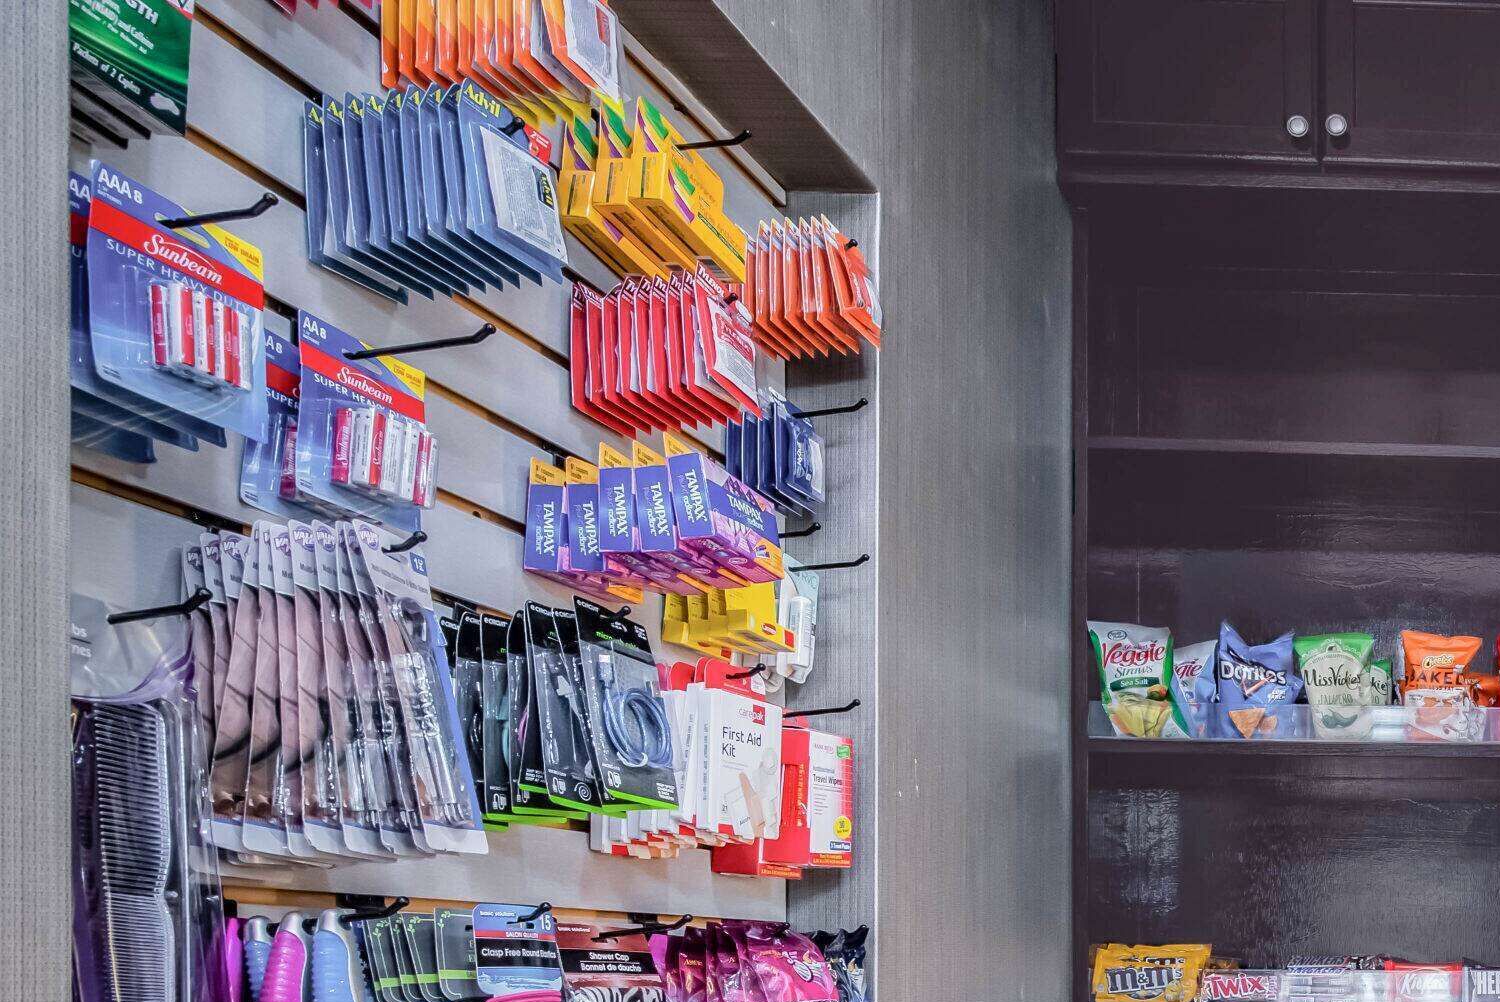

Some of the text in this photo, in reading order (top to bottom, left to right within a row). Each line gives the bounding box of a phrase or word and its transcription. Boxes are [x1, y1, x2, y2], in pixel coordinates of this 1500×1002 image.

[463, 83, 501, 118] Advil
[98, 168, 132, 199] AAA
[143, 233, 224, 286] Sunbeam
[106, 238, 251, 313] SUPER HEAVY DUTY
[303, 316, 319, 336] AA
[314, 372, 349, 397] SUPER
[336, 366, 393, 405] Sunbeam
[684, 468, 708, 522] TAMPAX
[726, 493, 764, 523] TAMPAX
[613, 483, 630, 537] TAMPAX
[650, 481, 671, 536] TAMPAX
[543, 501, 555, 556] TAMPAX
[582, 500, 600, 556] TAMPAX
[1101, 641, 1165, 669] Veggie
[1422, 654, 1455, 669] Cheetos
[1115, 665, 1153, 679] Straws
[1120, 678, 1148, 687] Sea Salt
[1220, 660, 1287, 686] Doritos
[1303, 669, 1329, 688] Miss
[722, 726, 762, 748] First Aid
[721, 743, 736, 758] Kit
[540, 915, 551, 931] 15
[481, 948, 540, 959] Clasp Free Round
[589, 952, 630, 963] Shower Cap
[580, 962, 642, 973] Bonnet de douche
